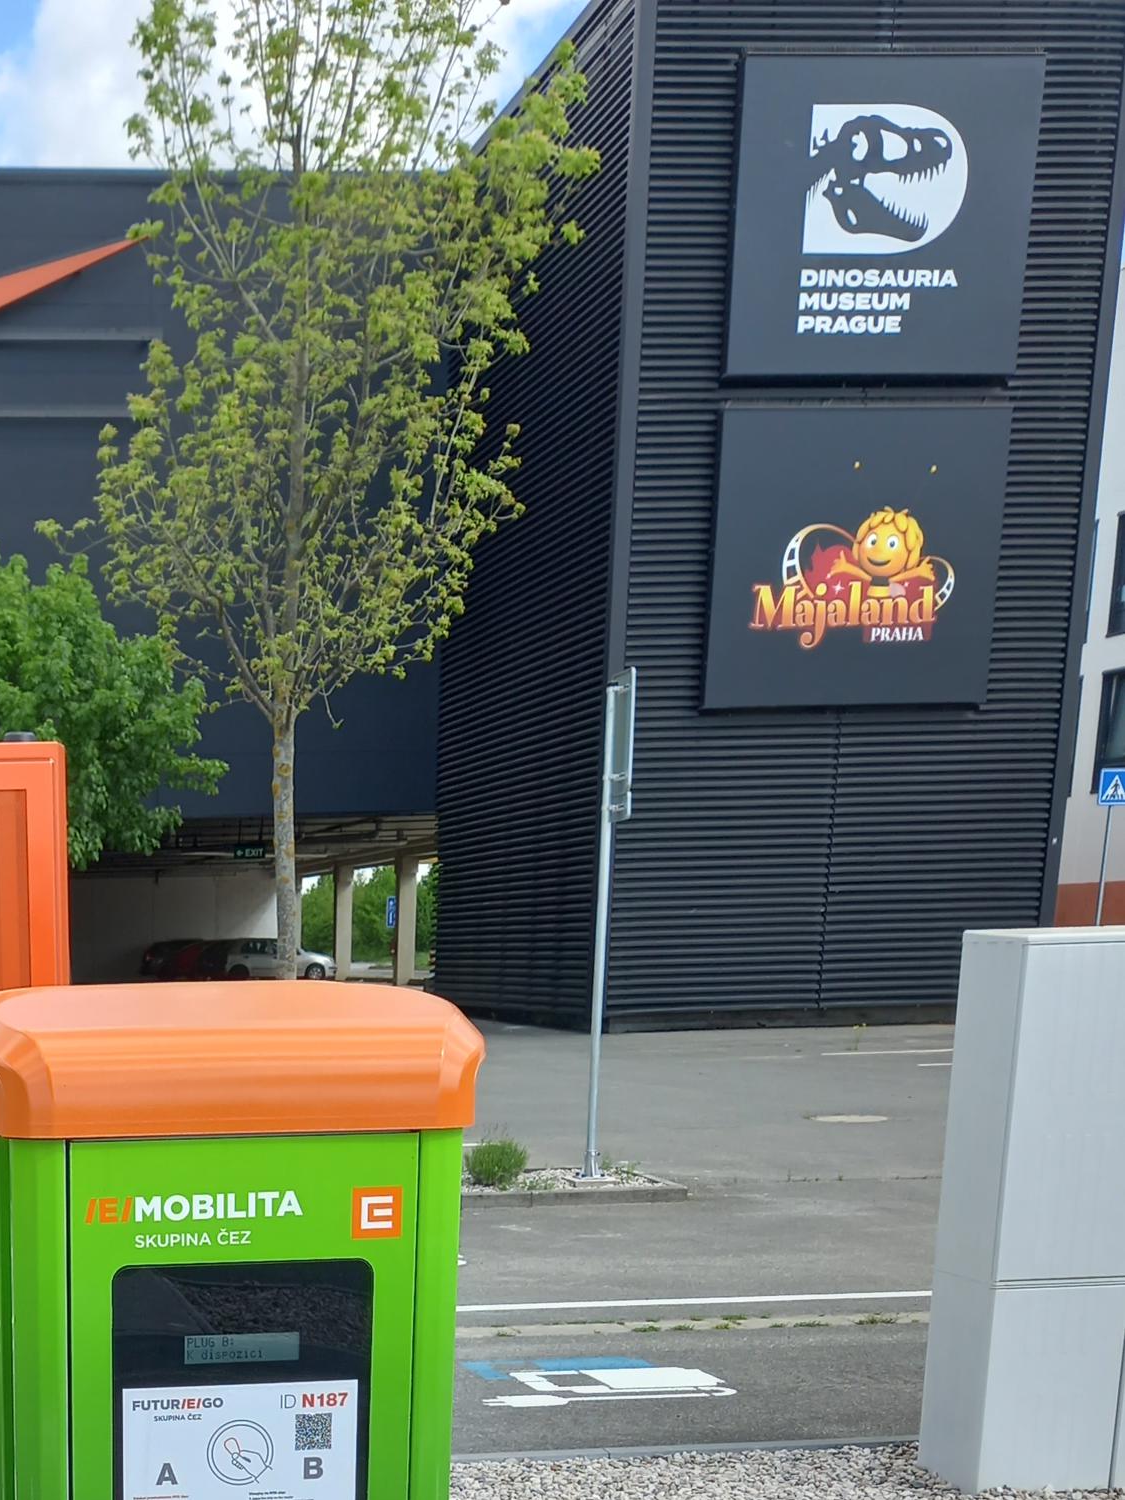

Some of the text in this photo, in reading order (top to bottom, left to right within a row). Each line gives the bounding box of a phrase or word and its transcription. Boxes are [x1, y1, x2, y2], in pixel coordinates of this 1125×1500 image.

[800, 268, 958, 288] DINOSAURIA
[798, 292, 910, 311] MUSEUM
[797, 315, 902, 334] PRAGUE
[751, 581, 935, 648] Majaland
[870, 627, 924, 642] PRAHA
[244, 848, 264, 857] EXIT
[134, 1228, 251, 1248] SKUPINA ČEZ
[186, 1336, 234, 1348] PLUG B:
[280, 1392, 348, 1409] ID N187
[156, 1463, 178, 1485] A
[303, 1457, 324, 1479] B
